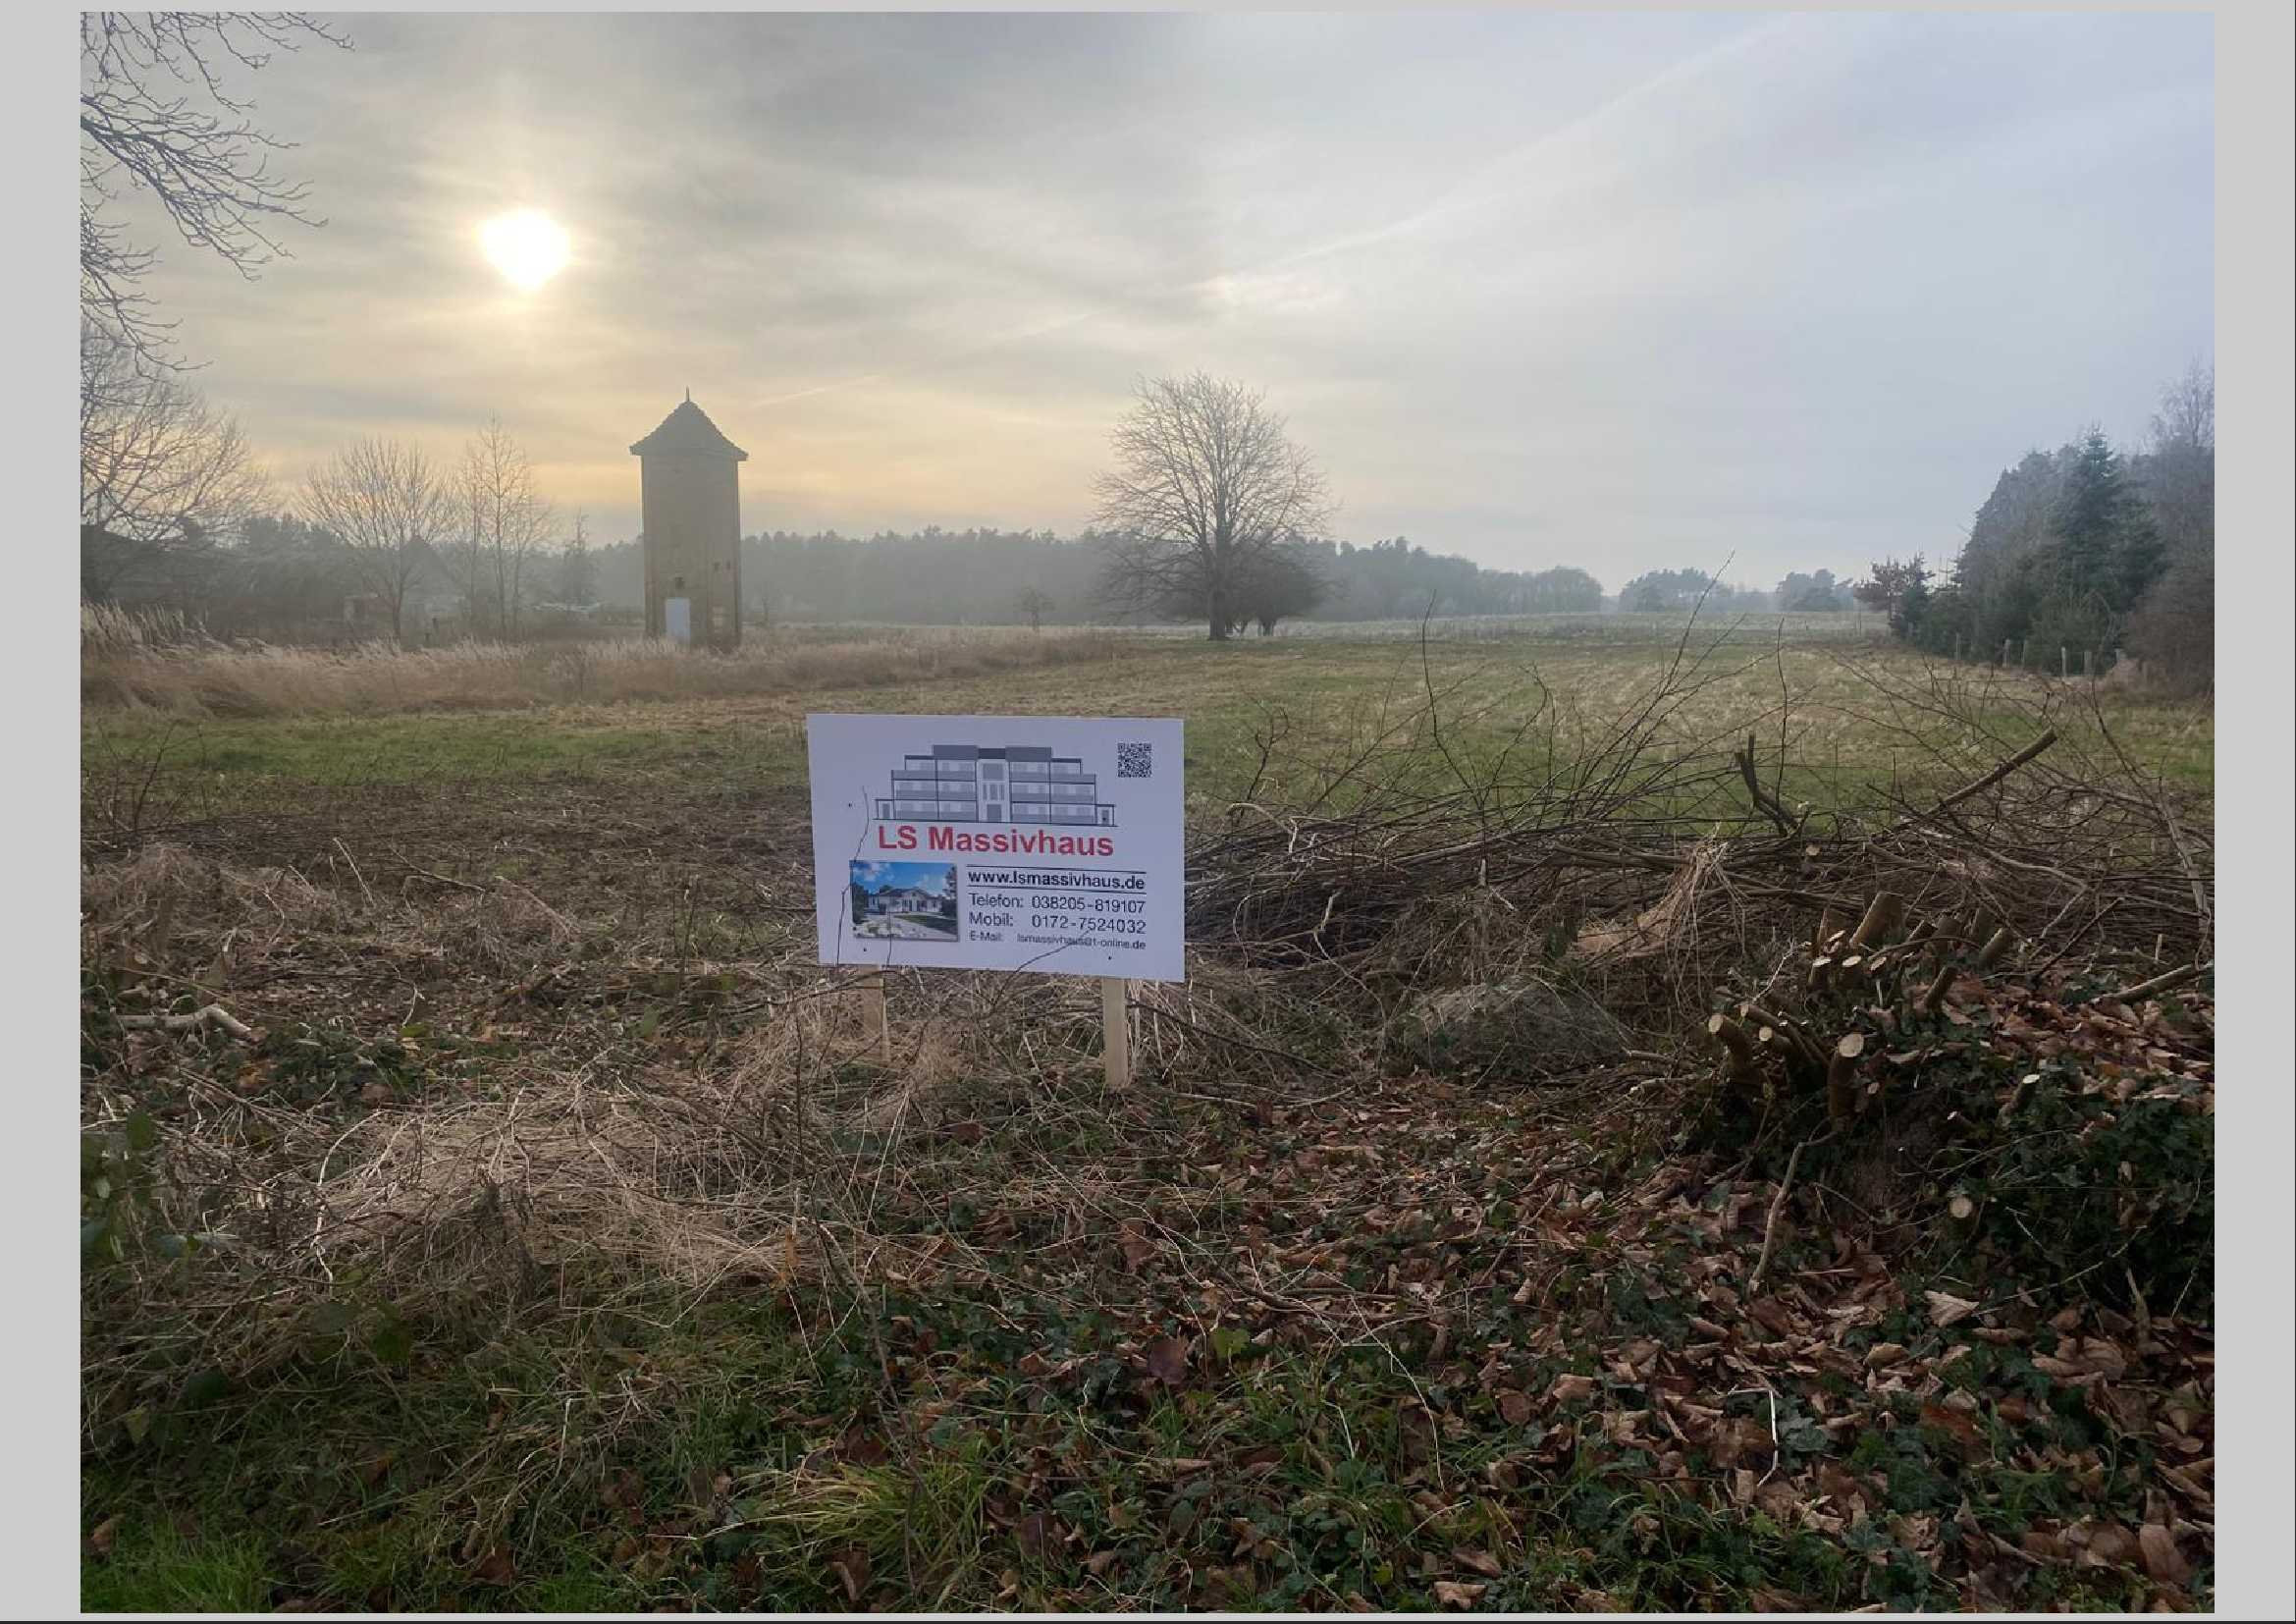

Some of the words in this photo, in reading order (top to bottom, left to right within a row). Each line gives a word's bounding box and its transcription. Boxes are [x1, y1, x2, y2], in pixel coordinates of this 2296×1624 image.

[879, 825, 918, 851] LS
[929, 826, 1114, 856] Massivhaus
[968, 871, 1145, 890] www.lsmassivhaus.de
[969, 893, 1024, 908] Telefon:
[1032, 895, 1146, 913] 038205-819107
[969, 912, 1014, 927] Mobil:
[1032, 914, 1147, 934] 0172-7524032
